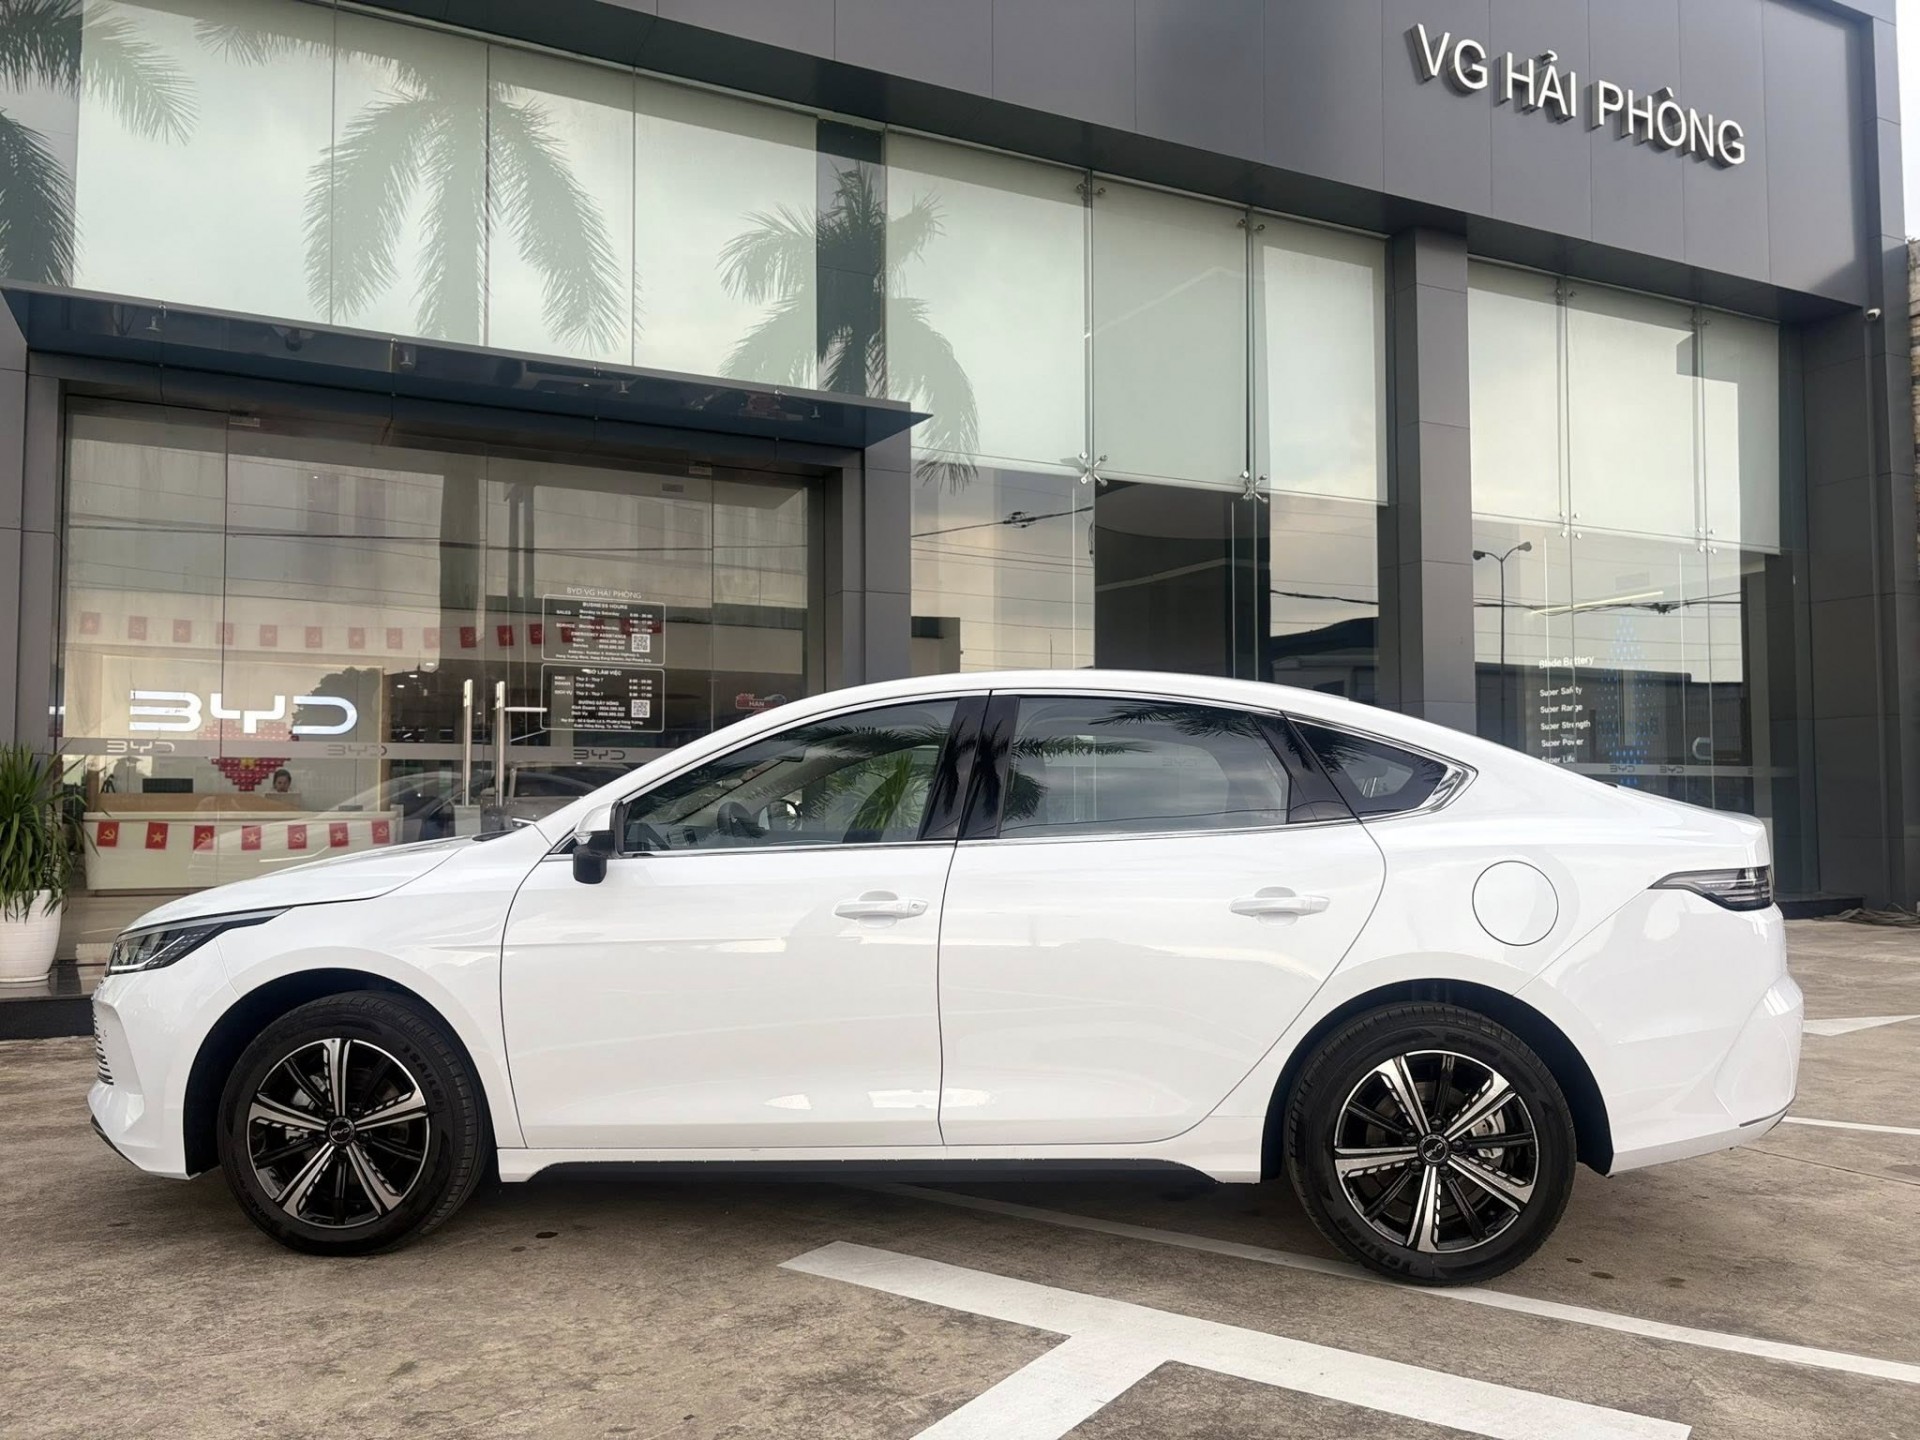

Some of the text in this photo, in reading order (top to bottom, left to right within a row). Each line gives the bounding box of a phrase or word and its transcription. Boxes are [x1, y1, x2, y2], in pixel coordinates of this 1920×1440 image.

[1411, 23, 1745, 165] VG HẢI PHÒNG
[567, 586, 582, 595] BYD
[584, 587, 595, 596] VG
[1539, 656, 1594, 668] Blade Battery
[1540, 688, 1559, 697] Super
[129, 690, 358, 735] BYD
[1540, 704, 1583, 714] Super Range
[1541, 720, 1591, 731] Super Strength
[106, 740, 175, 754] BYD
[1541, 738, 1584, 748] Super Power
[327, 744, 387, 757] BYD
[573, 749, 626, 760] BYD
[1610, 764, 1635, 773] BYD
[1660, 765, 1684, 774] BYD
